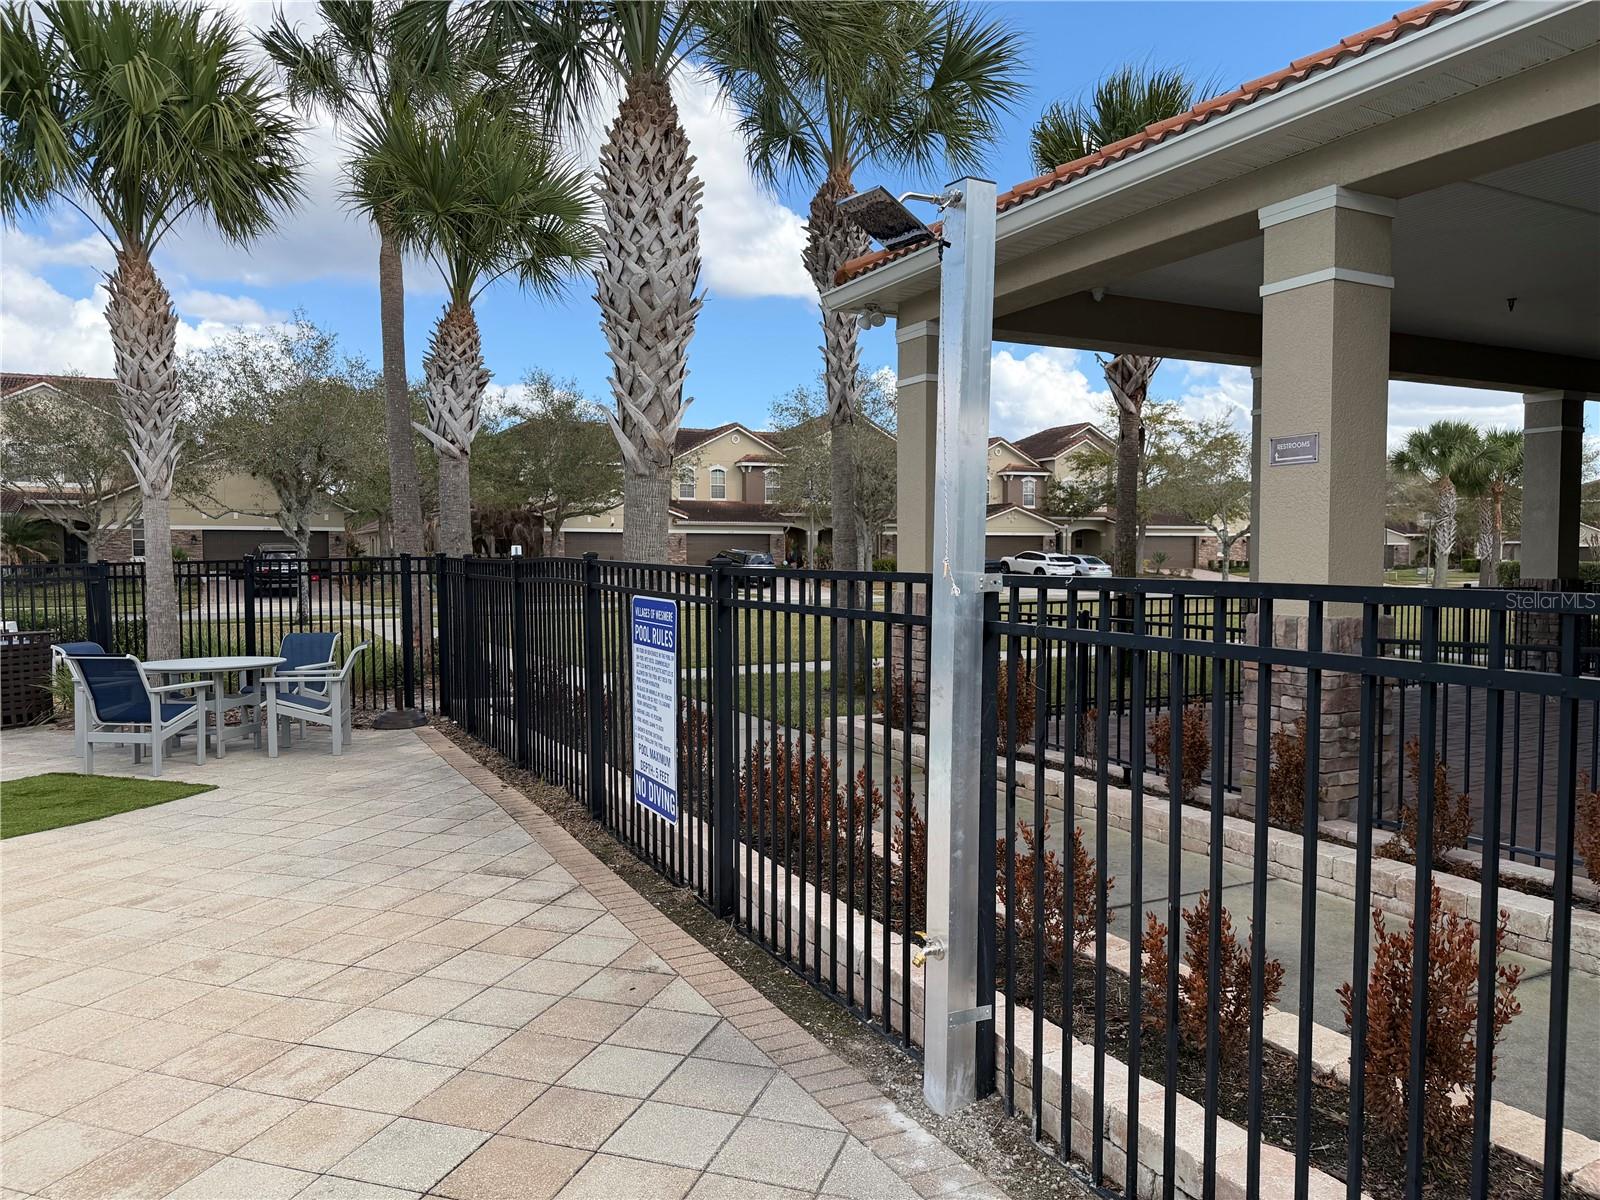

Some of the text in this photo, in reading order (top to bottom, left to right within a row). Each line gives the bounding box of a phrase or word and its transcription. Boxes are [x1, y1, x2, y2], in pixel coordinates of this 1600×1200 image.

[1277, 441, 1310, 450] RESTROOMS
[635, 624, 673, 648] POOL RULES
[638, 743, 649, 758] POOL
[649, 748, 671, 767] MAXIMUM
[659, 769, 670, 784] FEET
[635, 773, 676, 816] NO DIVING
